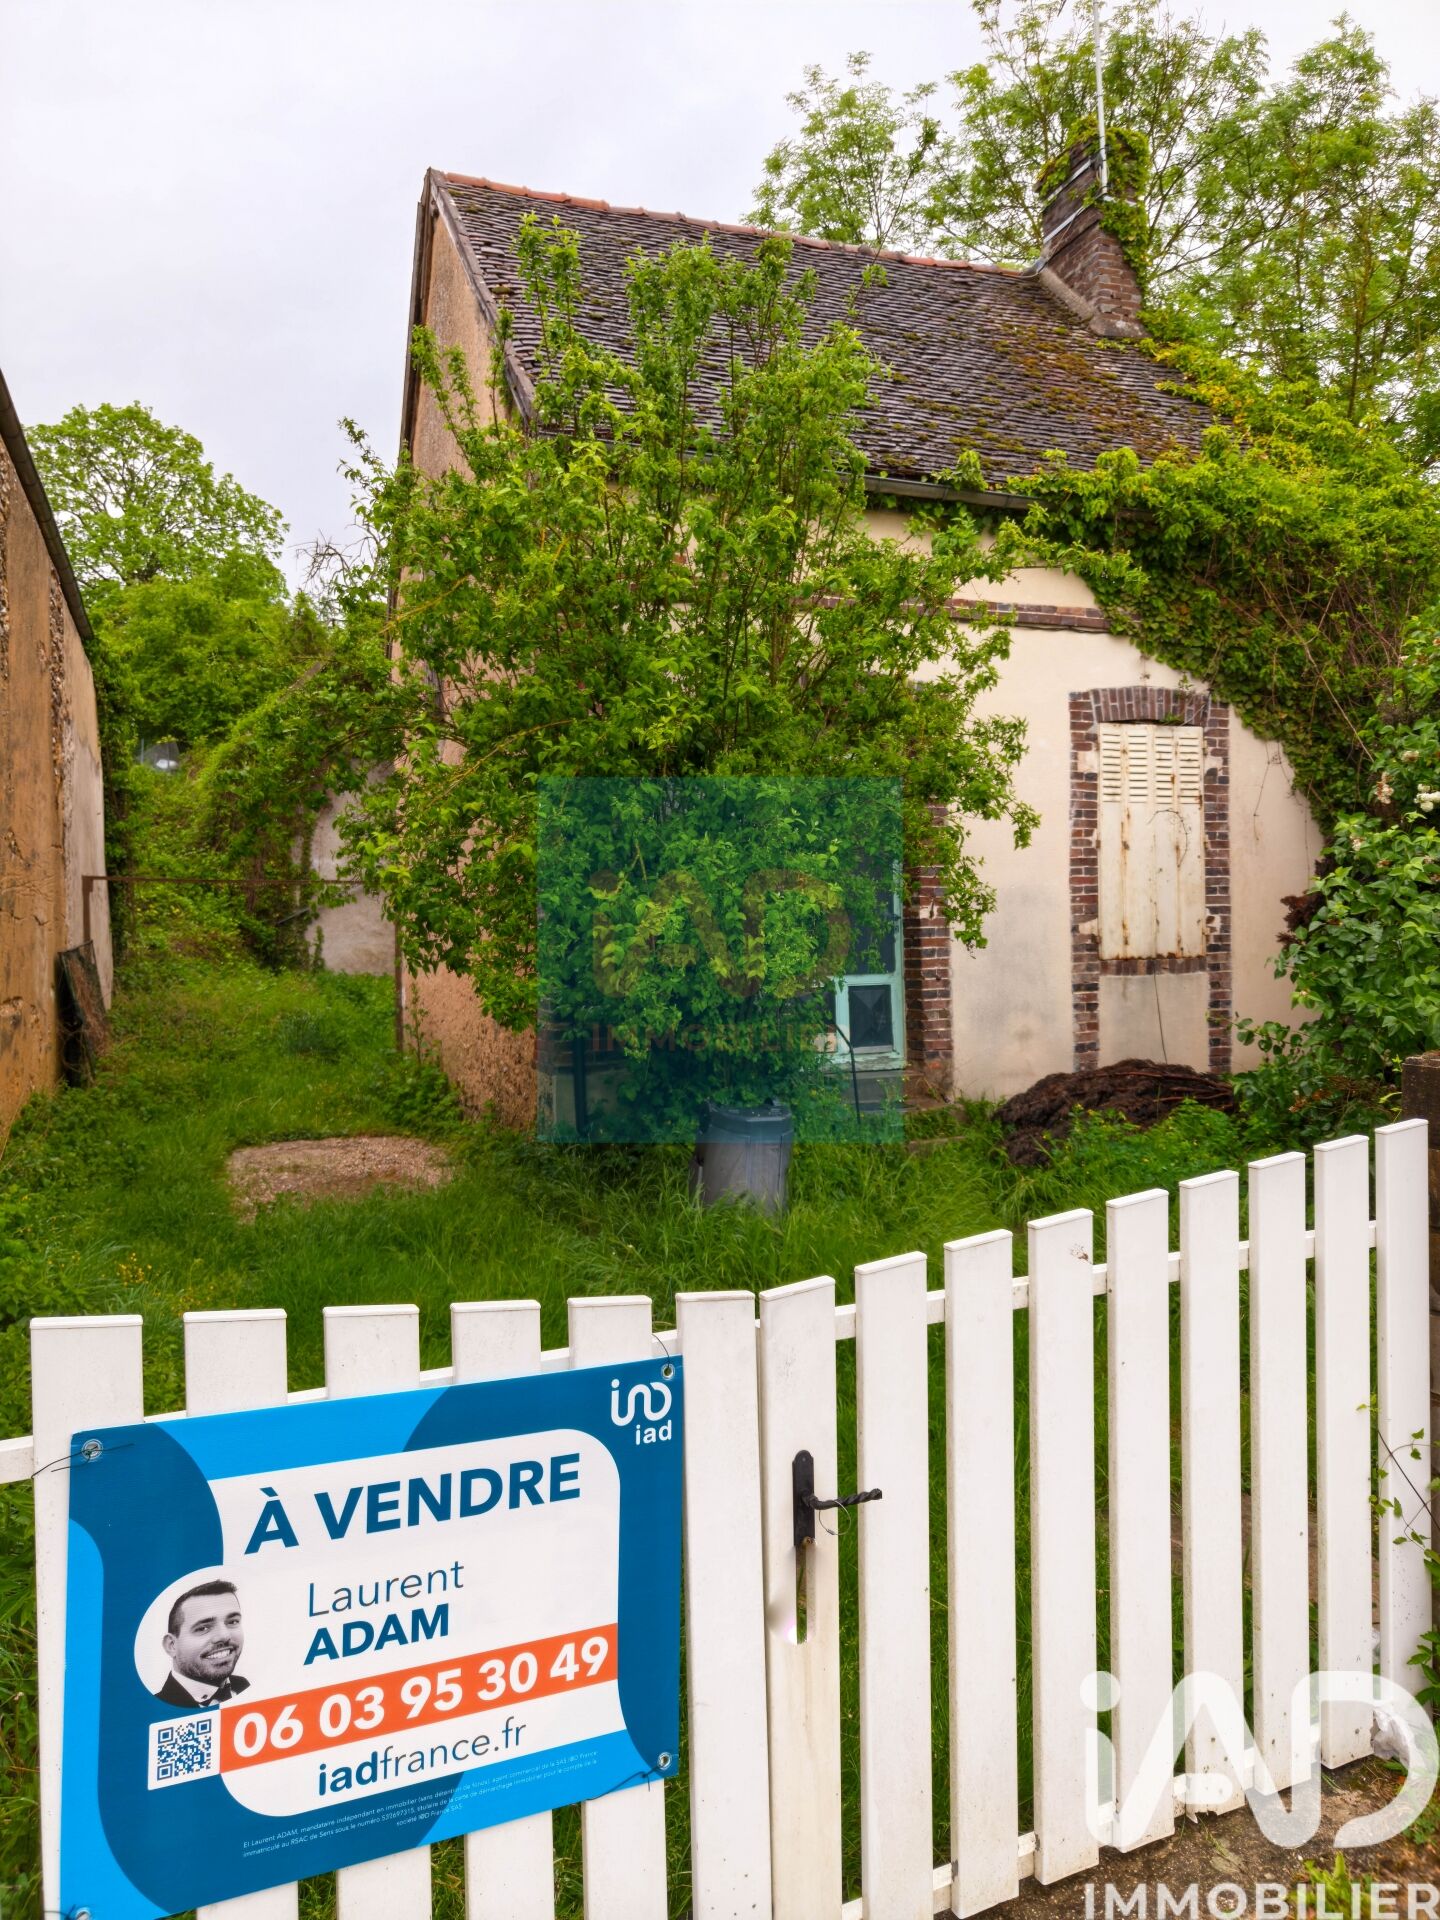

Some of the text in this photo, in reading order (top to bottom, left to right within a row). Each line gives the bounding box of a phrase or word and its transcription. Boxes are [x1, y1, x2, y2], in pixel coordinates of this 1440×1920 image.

[635, 1420, 672, 1445] iad
[245, 1453, 581, 1555] À VENDRE
[307, 1560, 464, 1617] Laurent
[304, 1603, 449, 1665] ADAM
[233, 1636, 608, 1758] 06 03 95 30 49
[318, 1717, 526, 1795] iadfrance.fr
[251, 1835, 275, 1846] Laurent
[300, 1819, 334, 1833] mandataire
[336, 1808, 375, 1825] indépendant
[385, 1797, 416, 1811] immobilier
[509, 1765, 540, 1778] commercial
[396, 1816, 417, 1826] société
[430, 1807, 450, 1817] France
[242, 1843, 280, 1858] immatriculé
[290, 1835, 308, 1845] RSAC
[318, 1828, 333, 1837] Sens
[334, 1825, 349, 1833] sous
[357, 1816, 380, 1827] numéro
